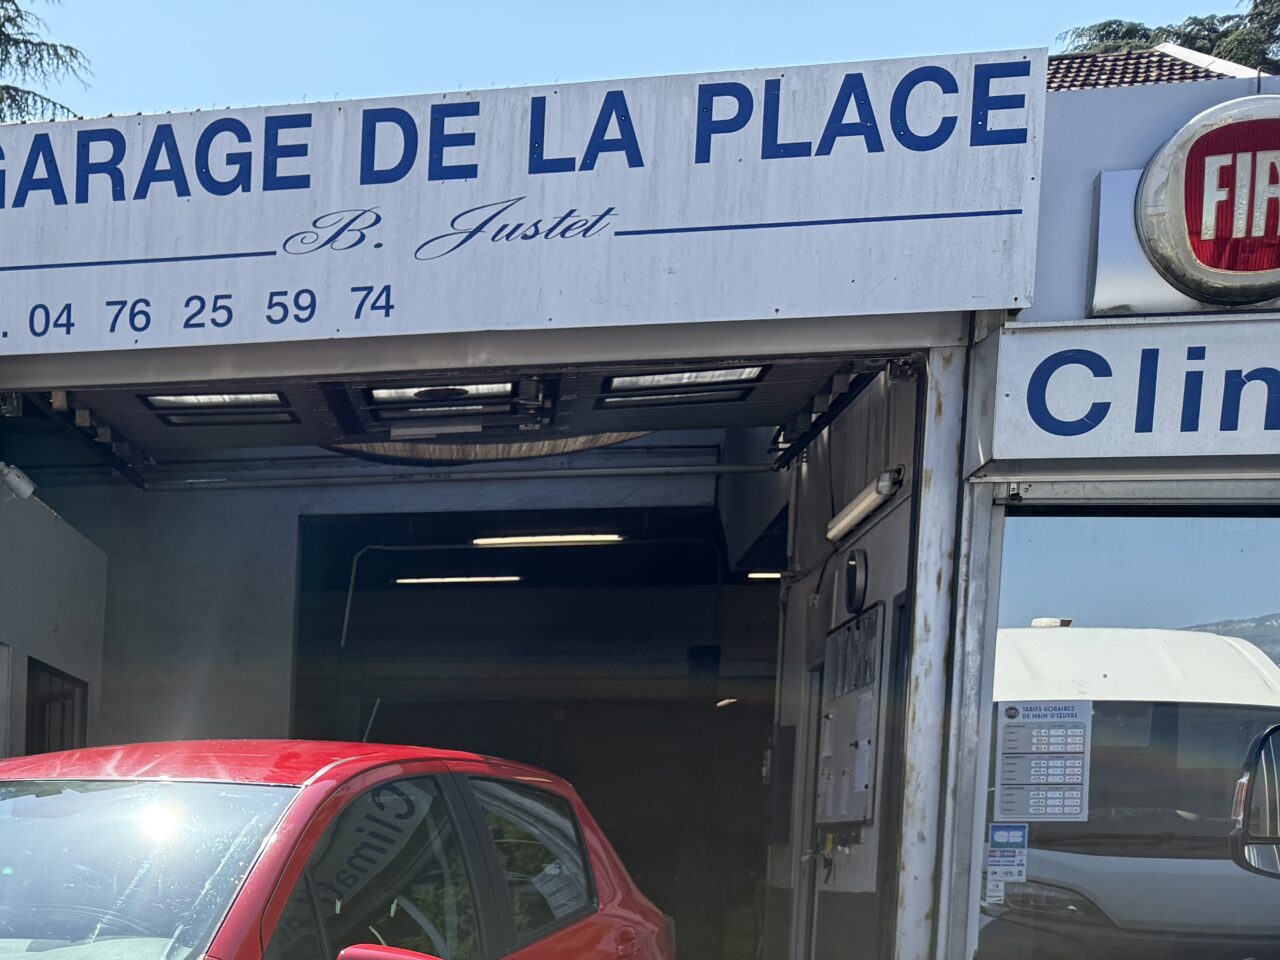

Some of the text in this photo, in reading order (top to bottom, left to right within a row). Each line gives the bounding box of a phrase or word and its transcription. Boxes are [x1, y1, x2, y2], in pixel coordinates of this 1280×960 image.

[359, 101, 481, 185] DE
[528, 90, 644, 174] LA
[694, 60, 1031, 165] PLACE
[283, 196, 612, 260] B. Justet
[29, 285, 394, 337] 04 76 25 59 74
